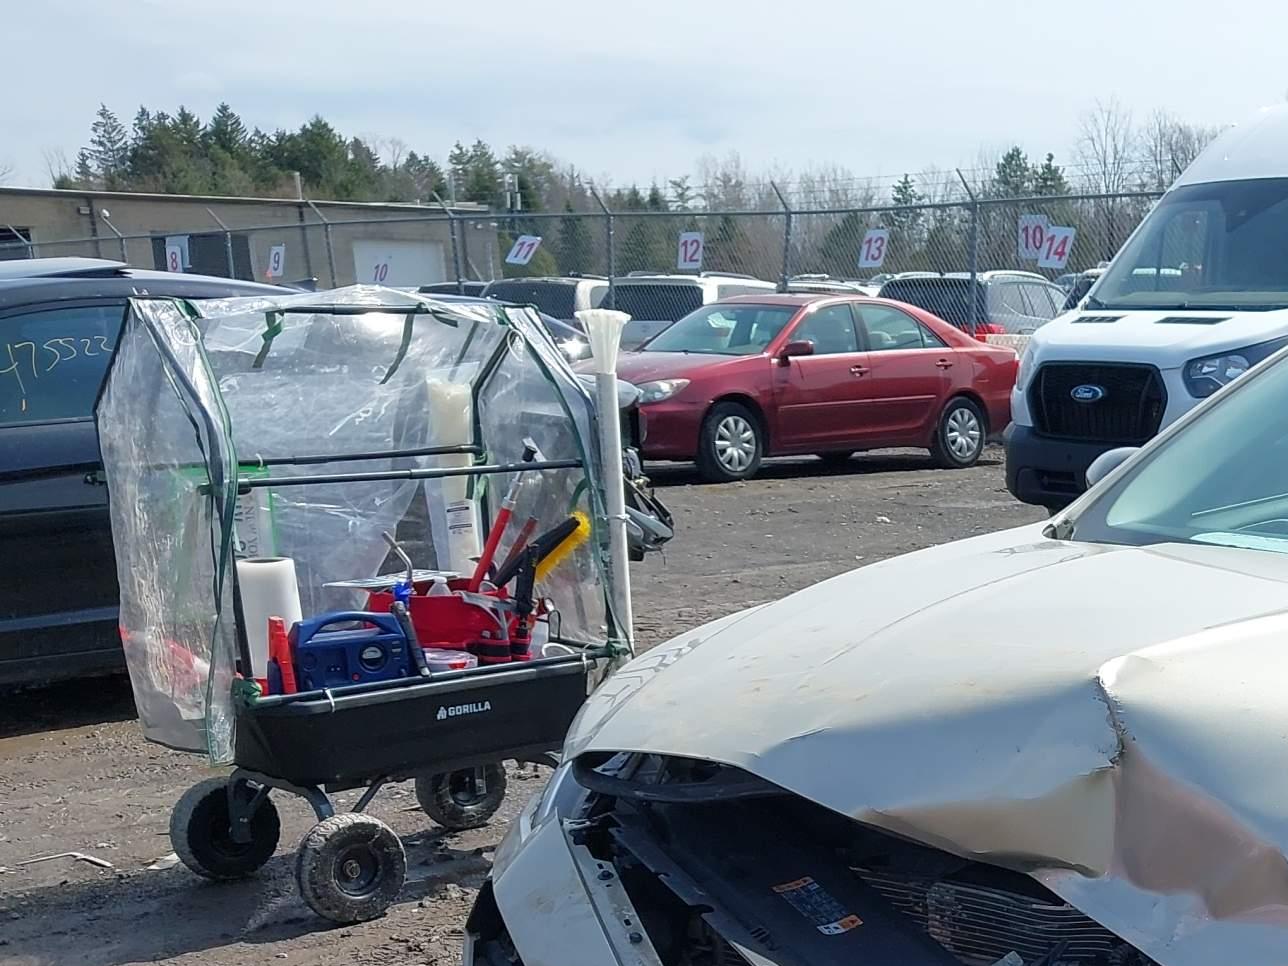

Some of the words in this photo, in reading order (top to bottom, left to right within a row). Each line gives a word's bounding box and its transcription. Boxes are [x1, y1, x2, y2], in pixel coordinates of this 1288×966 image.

[1022, 224, 1044, 250] 10
[512, 240, 535, 260] 11
[680, 238, 700, 263] 12
[864, 236, 885, 262] 13
[1046, 234, 1069, 262] 14
[170, 251, 178, 271] 8
[272, 251, 280, 271] 9
[373, 263, 389, 282] 10
[447, 700, 491, 717] GORILLA
